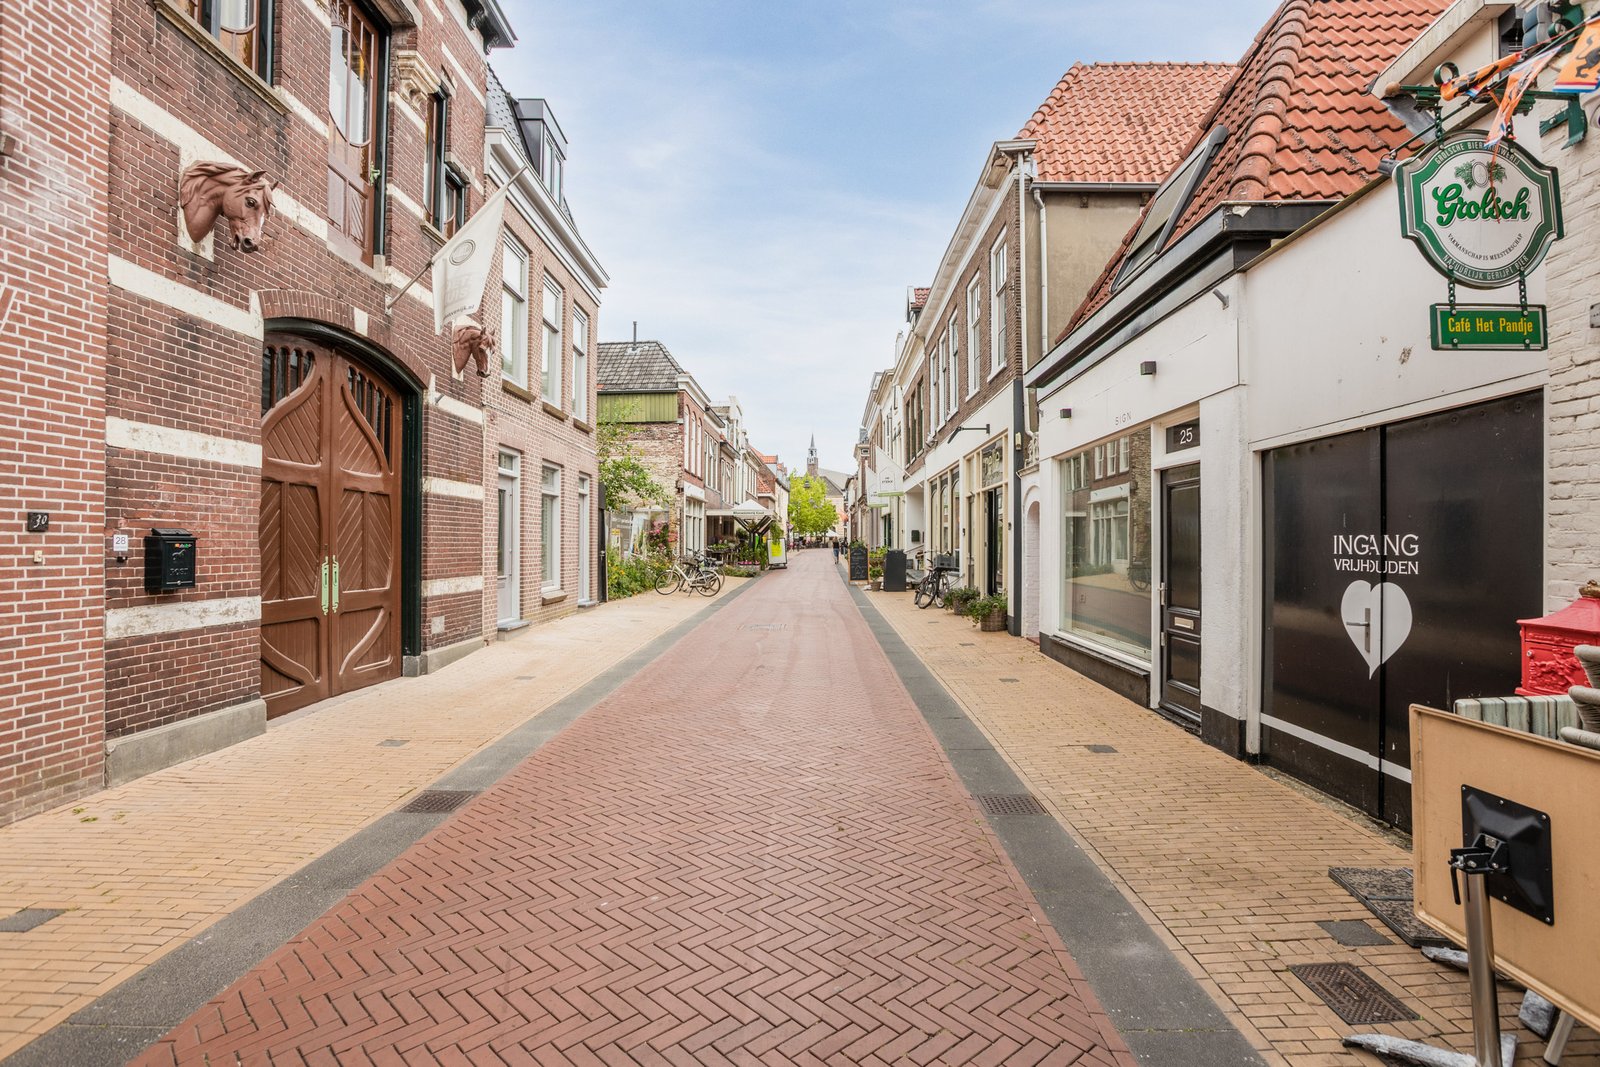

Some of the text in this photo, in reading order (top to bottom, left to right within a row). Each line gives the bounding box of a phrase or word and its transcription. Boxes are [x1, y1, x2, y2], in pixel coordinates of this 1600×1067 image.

[1434, 145, 1465, 165] GROLSCHE
[1432, 183, 1530, 226] Grolsch
[1448, 233, 1482, 260] VAKMANSCHAP
[1490, 233, 1523, 260] MEESTERSCHAP
[1443, 254, 1529, 280] NATUURLIJK GERIJPT BIER
[1448, 317, 1533, 335] Café Het Pandje
[1115, 412, 1132, 426] SIGN
[1180, 427, 1193, 444] 25
[33, 515, 48, 528] 30
[115, 537, 126, 545] 28
[1333, 534, 1419, 556] INGANG
[1334, 558, 1419, 575] VRIJHOUDEN
